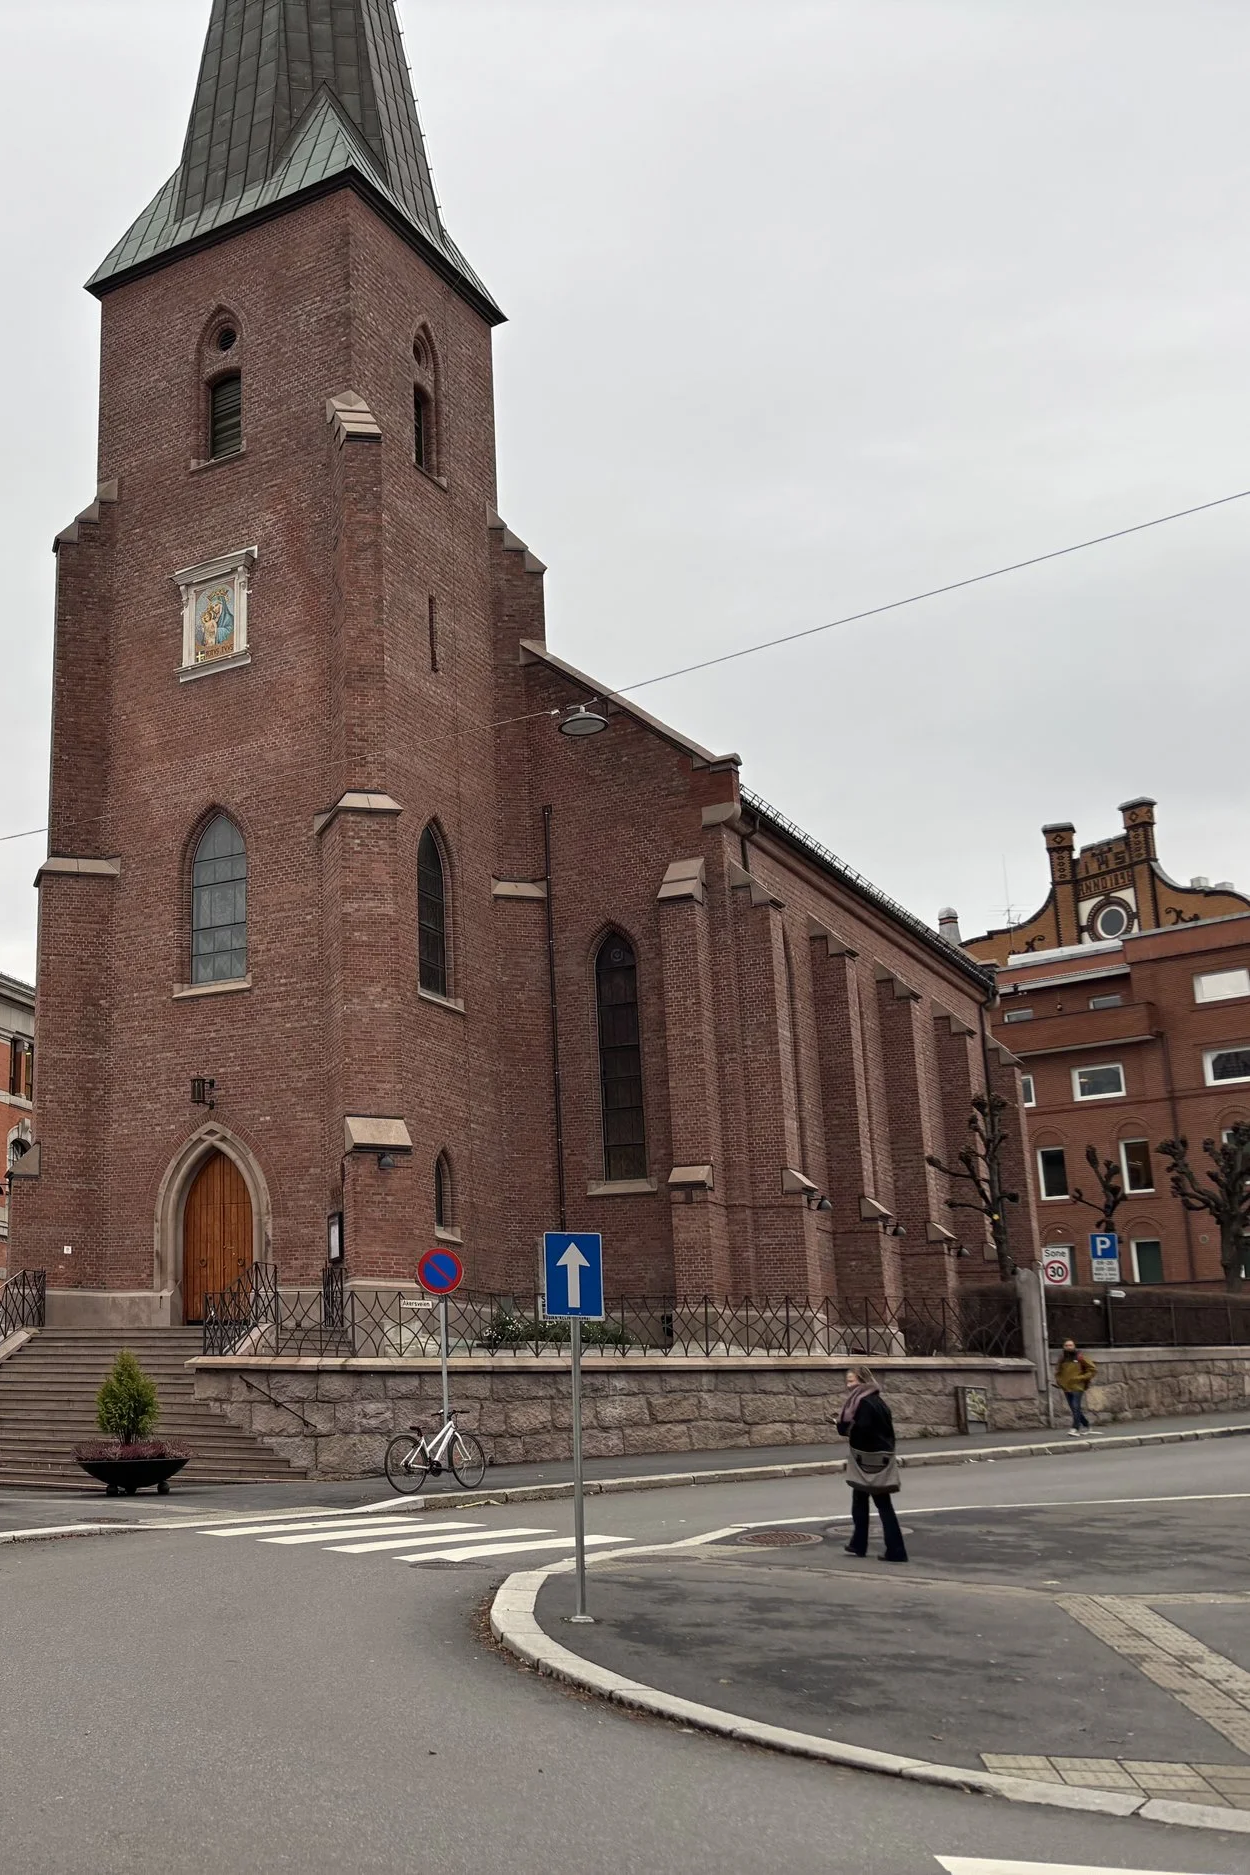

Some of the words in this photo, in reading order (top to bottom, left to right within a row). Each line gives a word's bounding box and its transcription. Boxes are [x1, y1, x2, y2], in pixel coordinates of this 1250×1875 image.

[1095, 1236, 1111, 1256] P
[1045, 1249, 1066, 1258] Sone
[1050, 1266, 1064, 1278] 30
